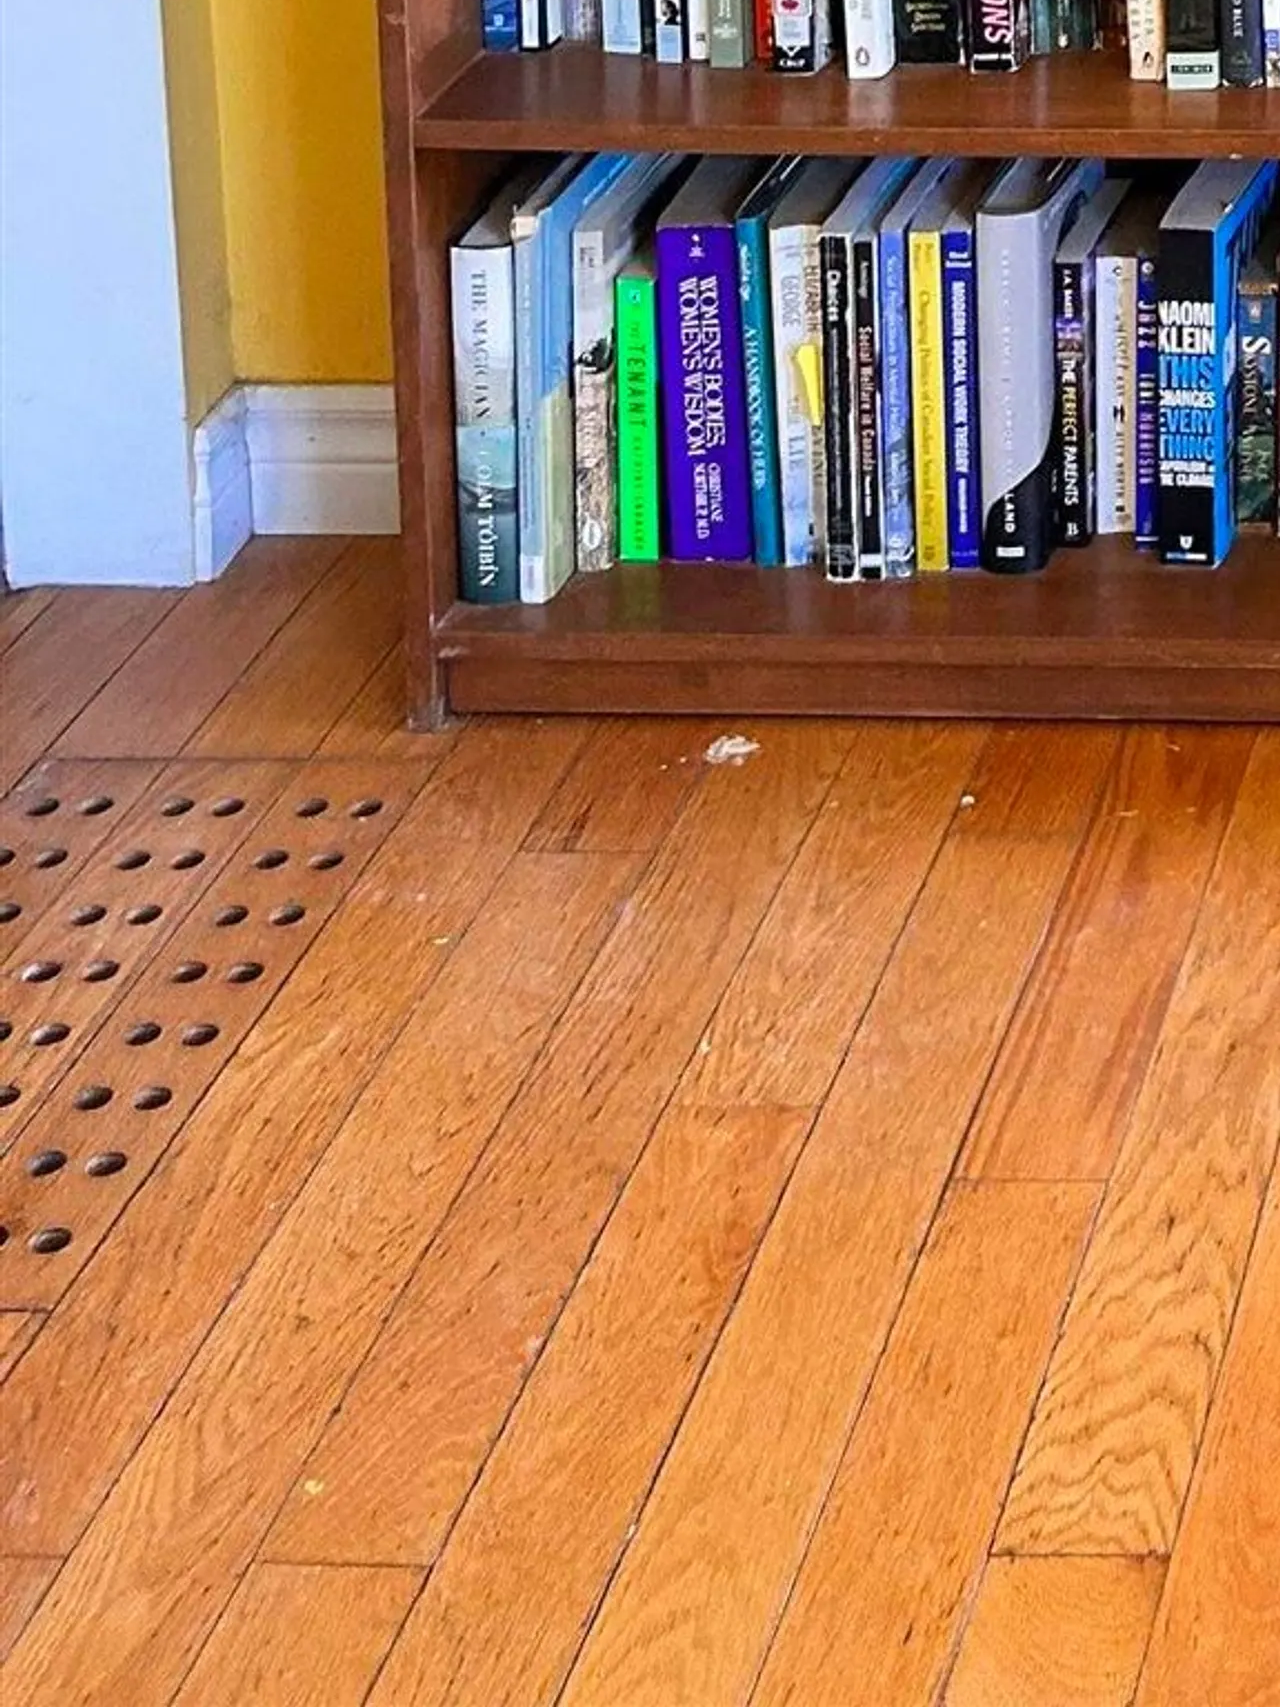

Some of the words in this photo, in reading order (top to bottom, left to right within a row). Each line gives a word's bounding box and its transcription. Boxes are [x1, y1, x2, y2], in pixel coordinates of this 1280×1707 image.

[678, 277, 703, 371] WOMEN'S
[698, 276, 722, 369] WOMEN'S
[1158, 327, 1216, 354] KLEIN
[627, 343, 646, 430] TENANT
[1062, 358, 1076, 384] THE
[1159, 355, 1215, 388] THIS
[684, 373, 706, 455] WISDOM
[1063, 387, 1077, 442] PERFECT
[1159, 408, 1215, 434] EVERY
[1063, 445, 1079, 506] PARENTS
